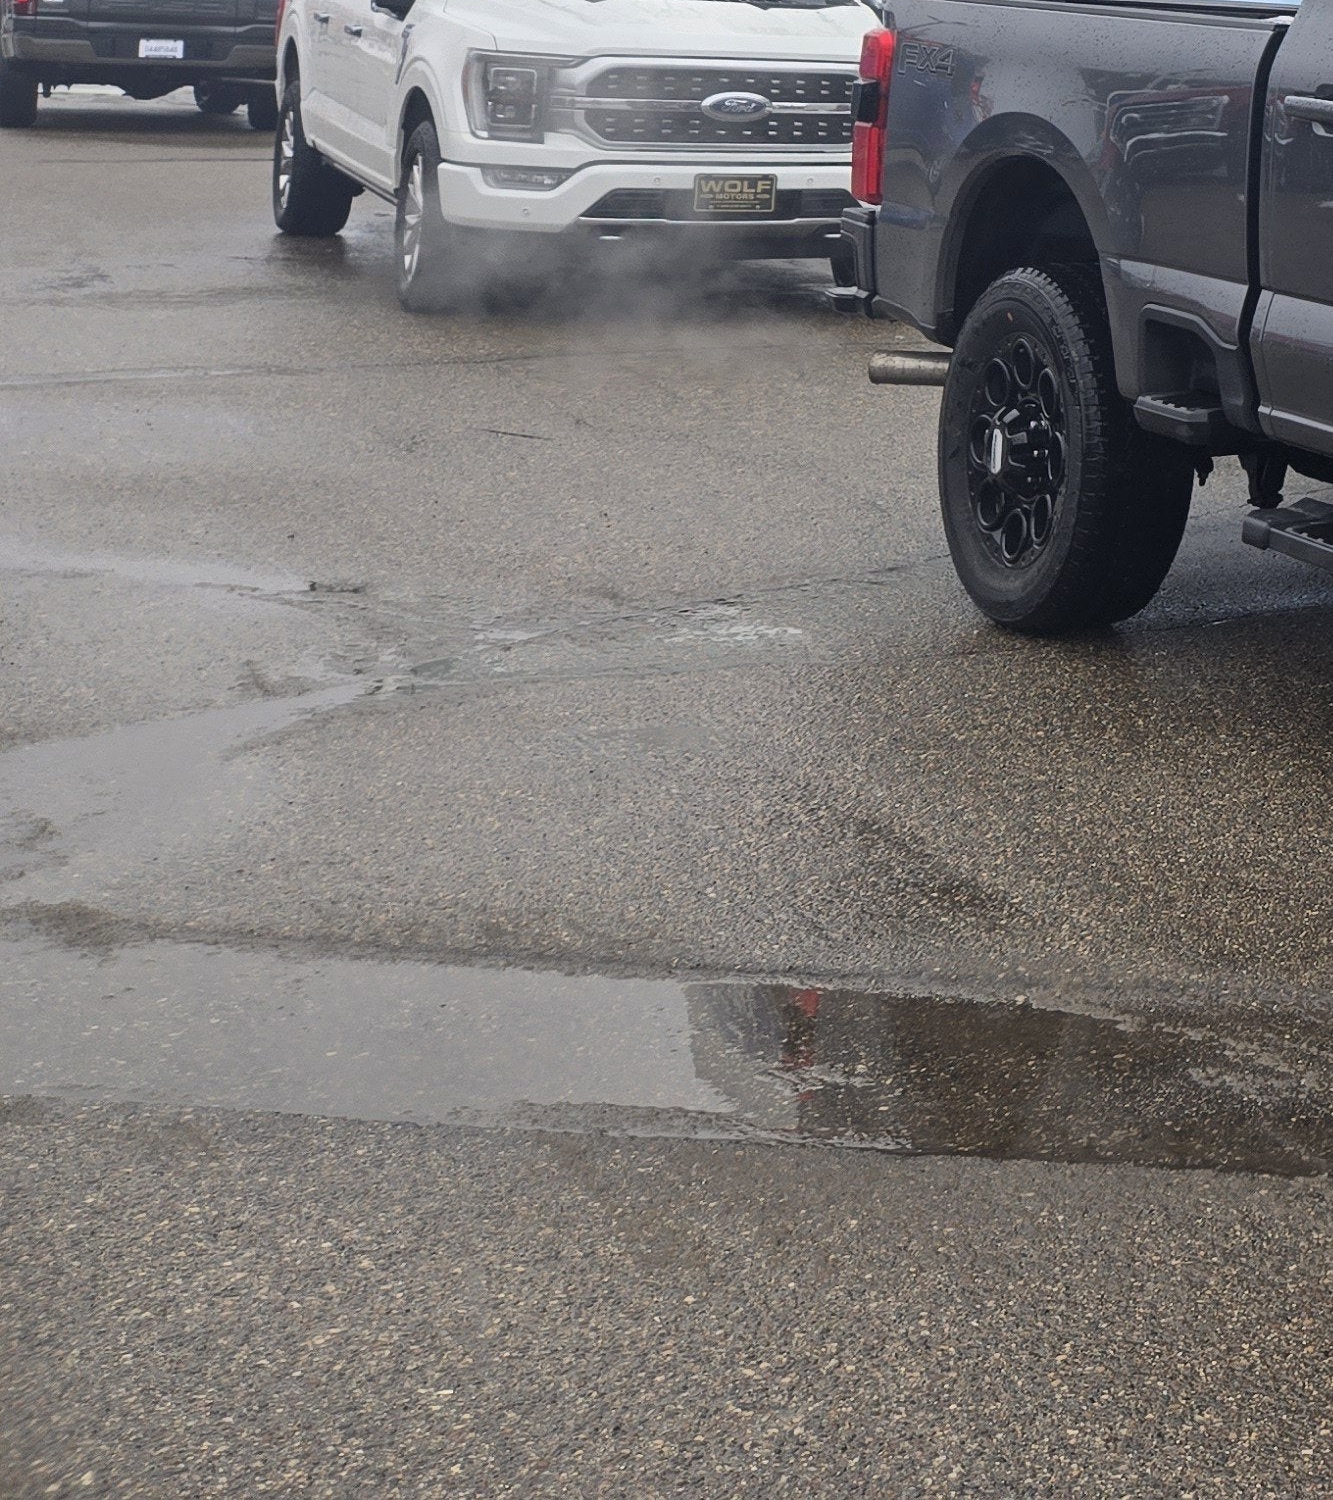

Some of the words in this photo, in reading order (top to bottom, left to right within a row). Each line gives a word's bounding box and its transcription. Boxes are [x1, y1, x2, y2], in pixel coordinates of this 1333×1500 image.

[897, 41, 957, 78] FX4
[721, 98, 757, 113] Ford
[700, 180, 771, 193] WOLF
